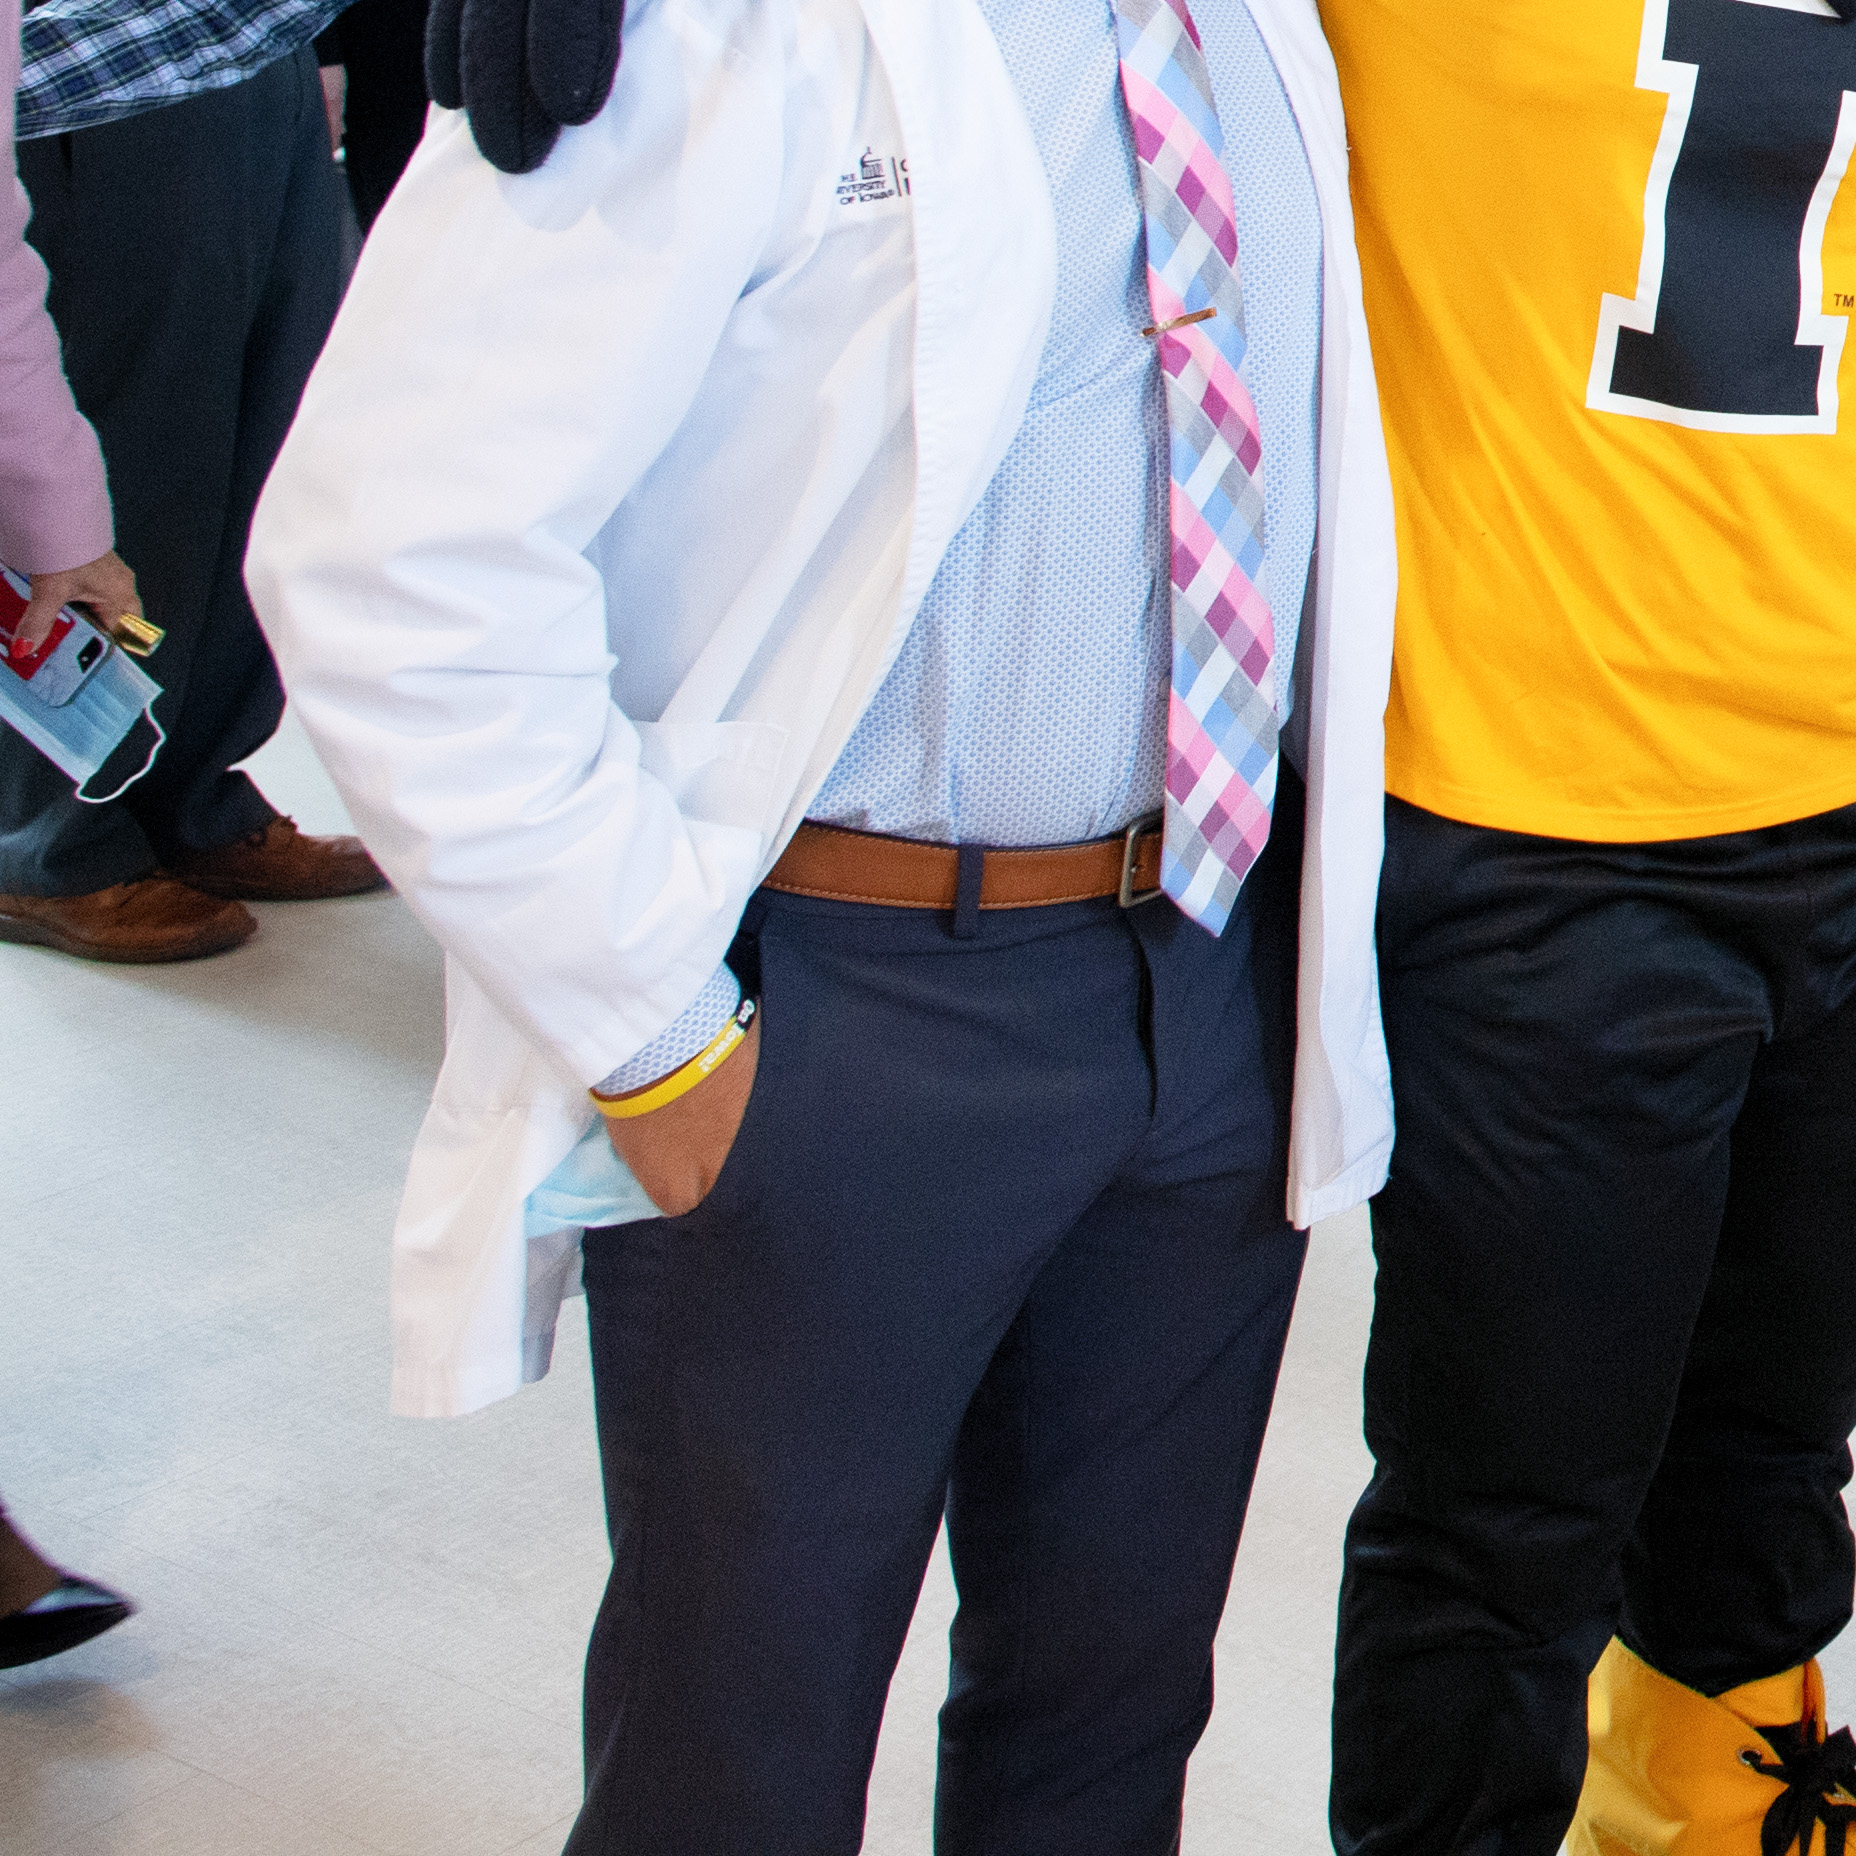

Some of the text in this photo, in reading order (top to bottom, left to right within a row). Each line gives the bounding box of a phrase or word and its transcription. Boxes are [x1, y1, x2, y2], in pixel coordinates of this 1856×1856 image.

[841, 174, 855, 182] HE
[1833, 293, 1855, 308] TM
[738, 999, 755, 1023] On
